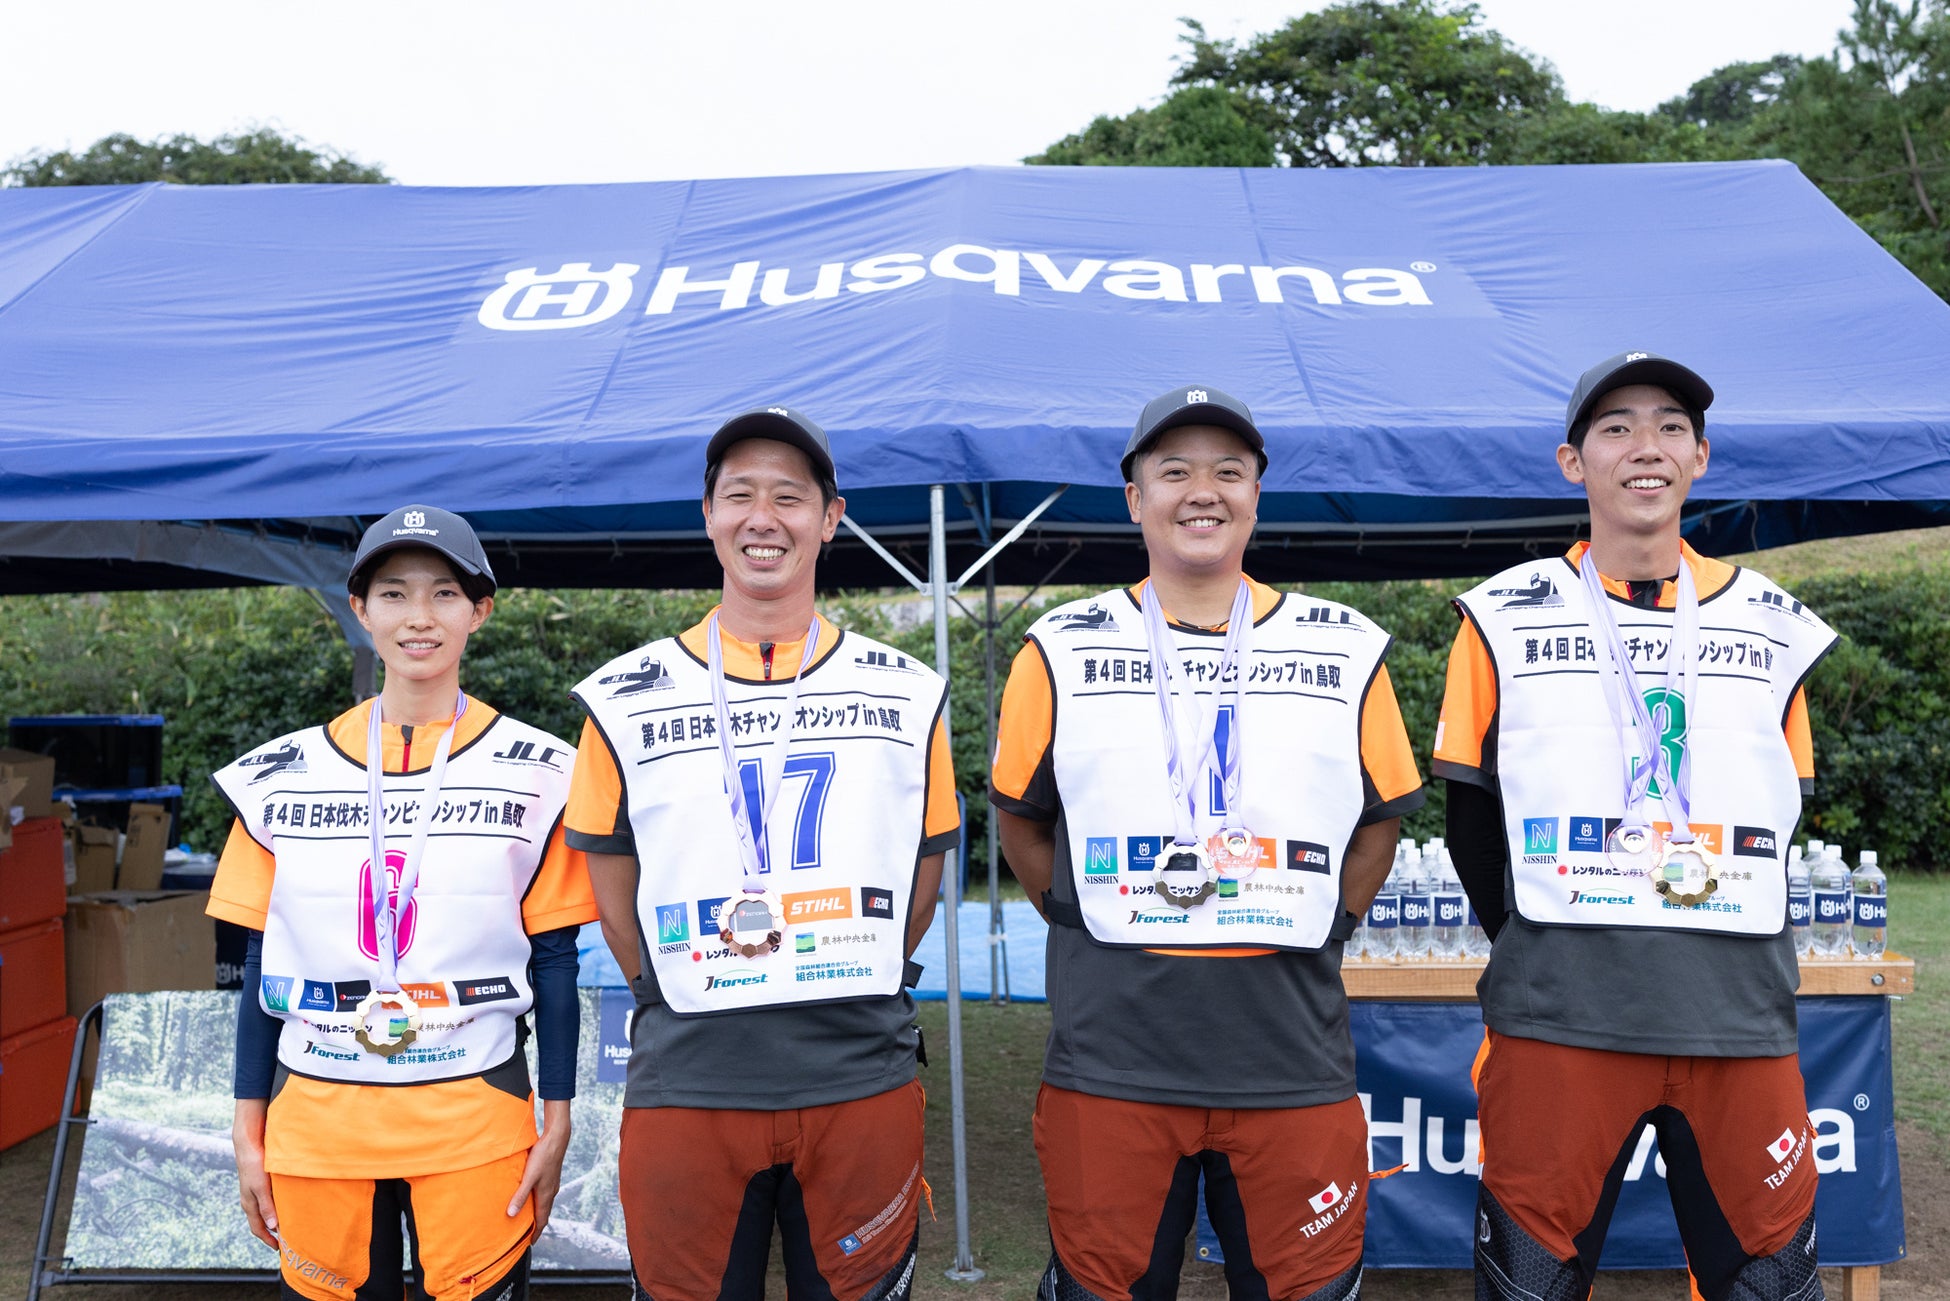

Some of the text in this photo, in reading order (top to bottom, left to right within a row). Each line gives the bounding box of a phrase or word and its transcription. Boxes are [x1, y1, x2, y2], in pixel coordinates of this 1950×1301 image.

[493, 740, 569, 768] JLC
[722, 751, 837, 877] 17
[1303, 850, 1327, 866] ECHO
[1522, 854, 1557, 865] NISSHIN
[1084, 875, 1119, 885] NISSHIN
[790, 897, 846, 916] STIHL
[1217, 914, 1294, 928] 組合林業株式会社
[658, 942, 691, 956] NISSHIN
[795, 966, 873, 983] 組合林業株式会社
[475, 984, 507, 996] ECHO
[1762, 1127, 1808, 1190] TEAM JAPAN
[1299, 1181, 1359, 1239] TEAM JAPAN
